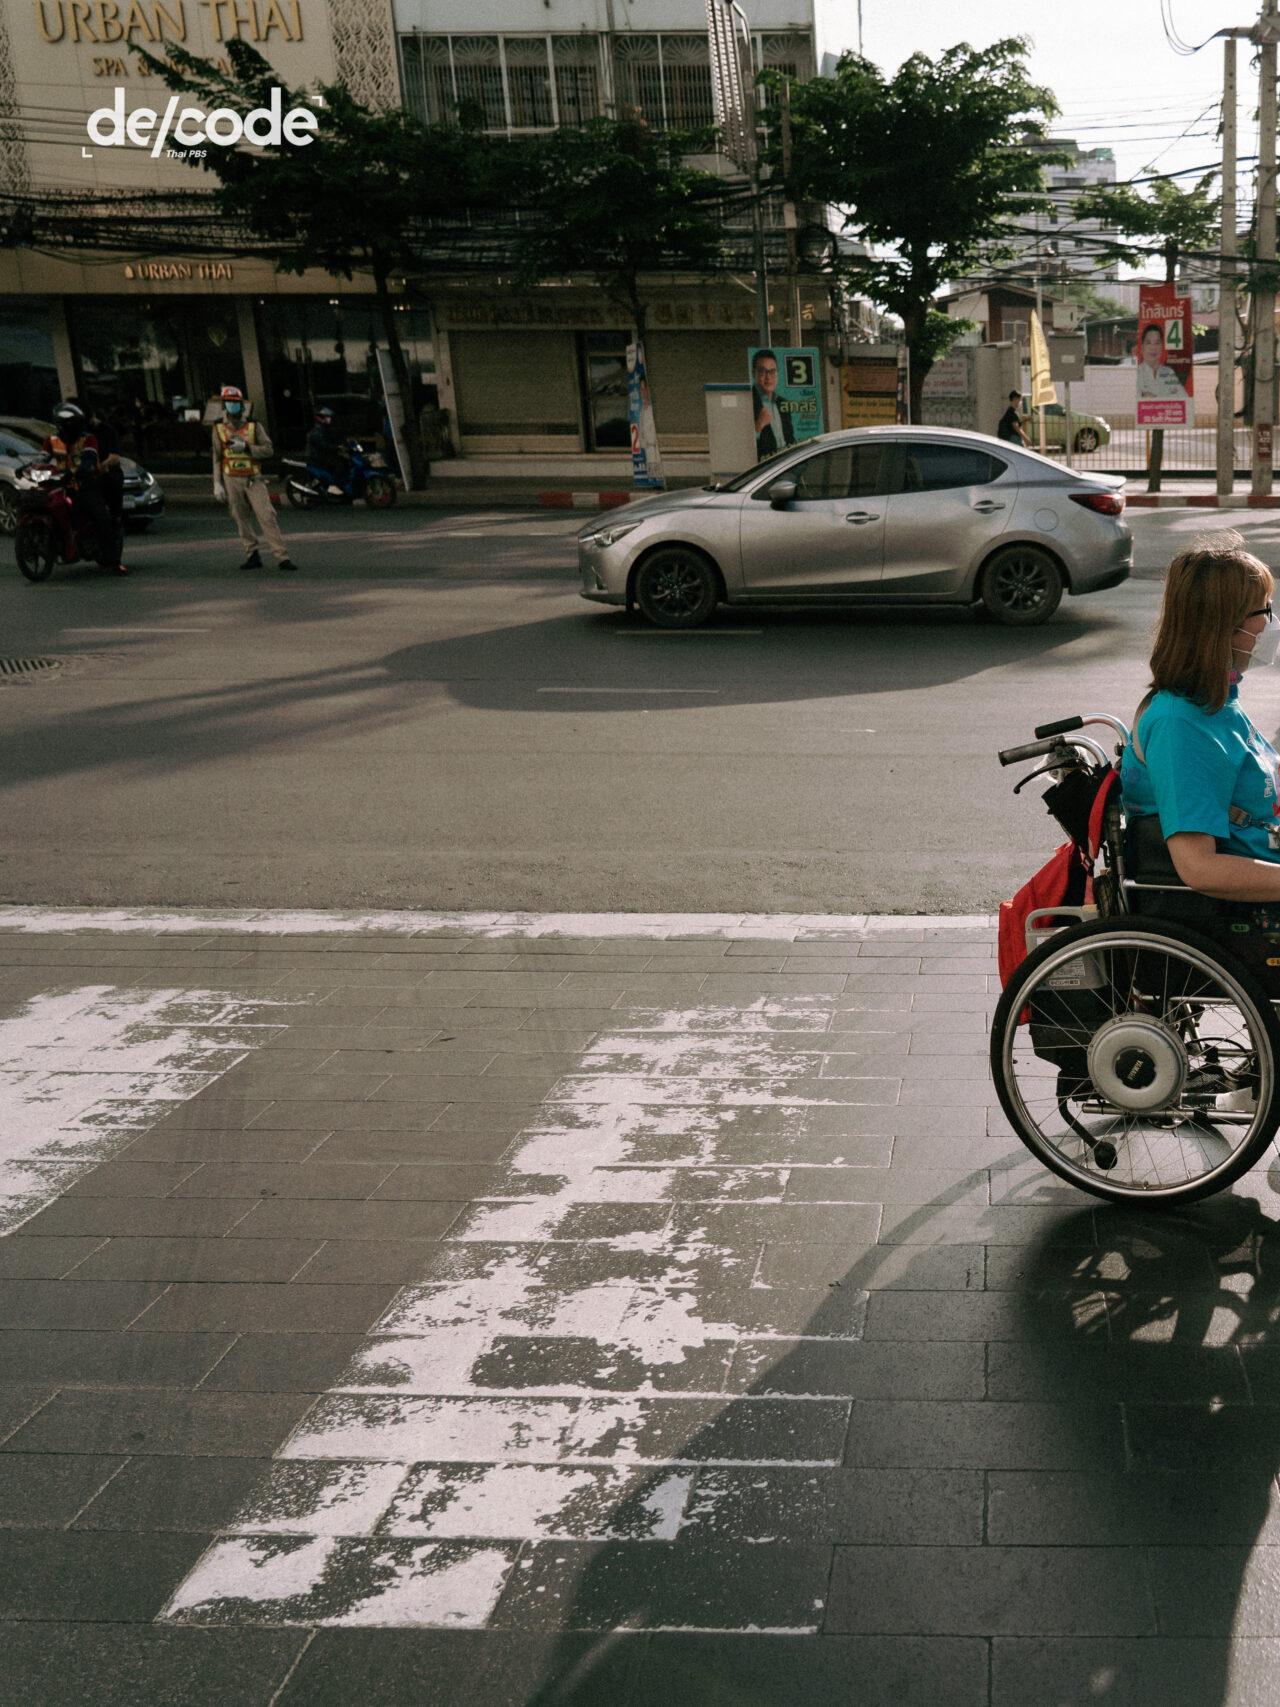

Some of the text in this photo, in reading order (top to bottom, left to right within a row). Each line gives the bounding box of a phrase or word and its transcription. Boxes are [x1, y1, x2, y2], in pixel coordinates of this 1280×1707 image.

[35, 0, 304, 43] URBAN THAI
[93, 57, 129, 77] SPA
[138, 263, 233, 279] URBAN THAI
[1167, 320, 1181, 348] 4
[791, 360, 808, 384] 3
[631, 425, 640, 453] 2
